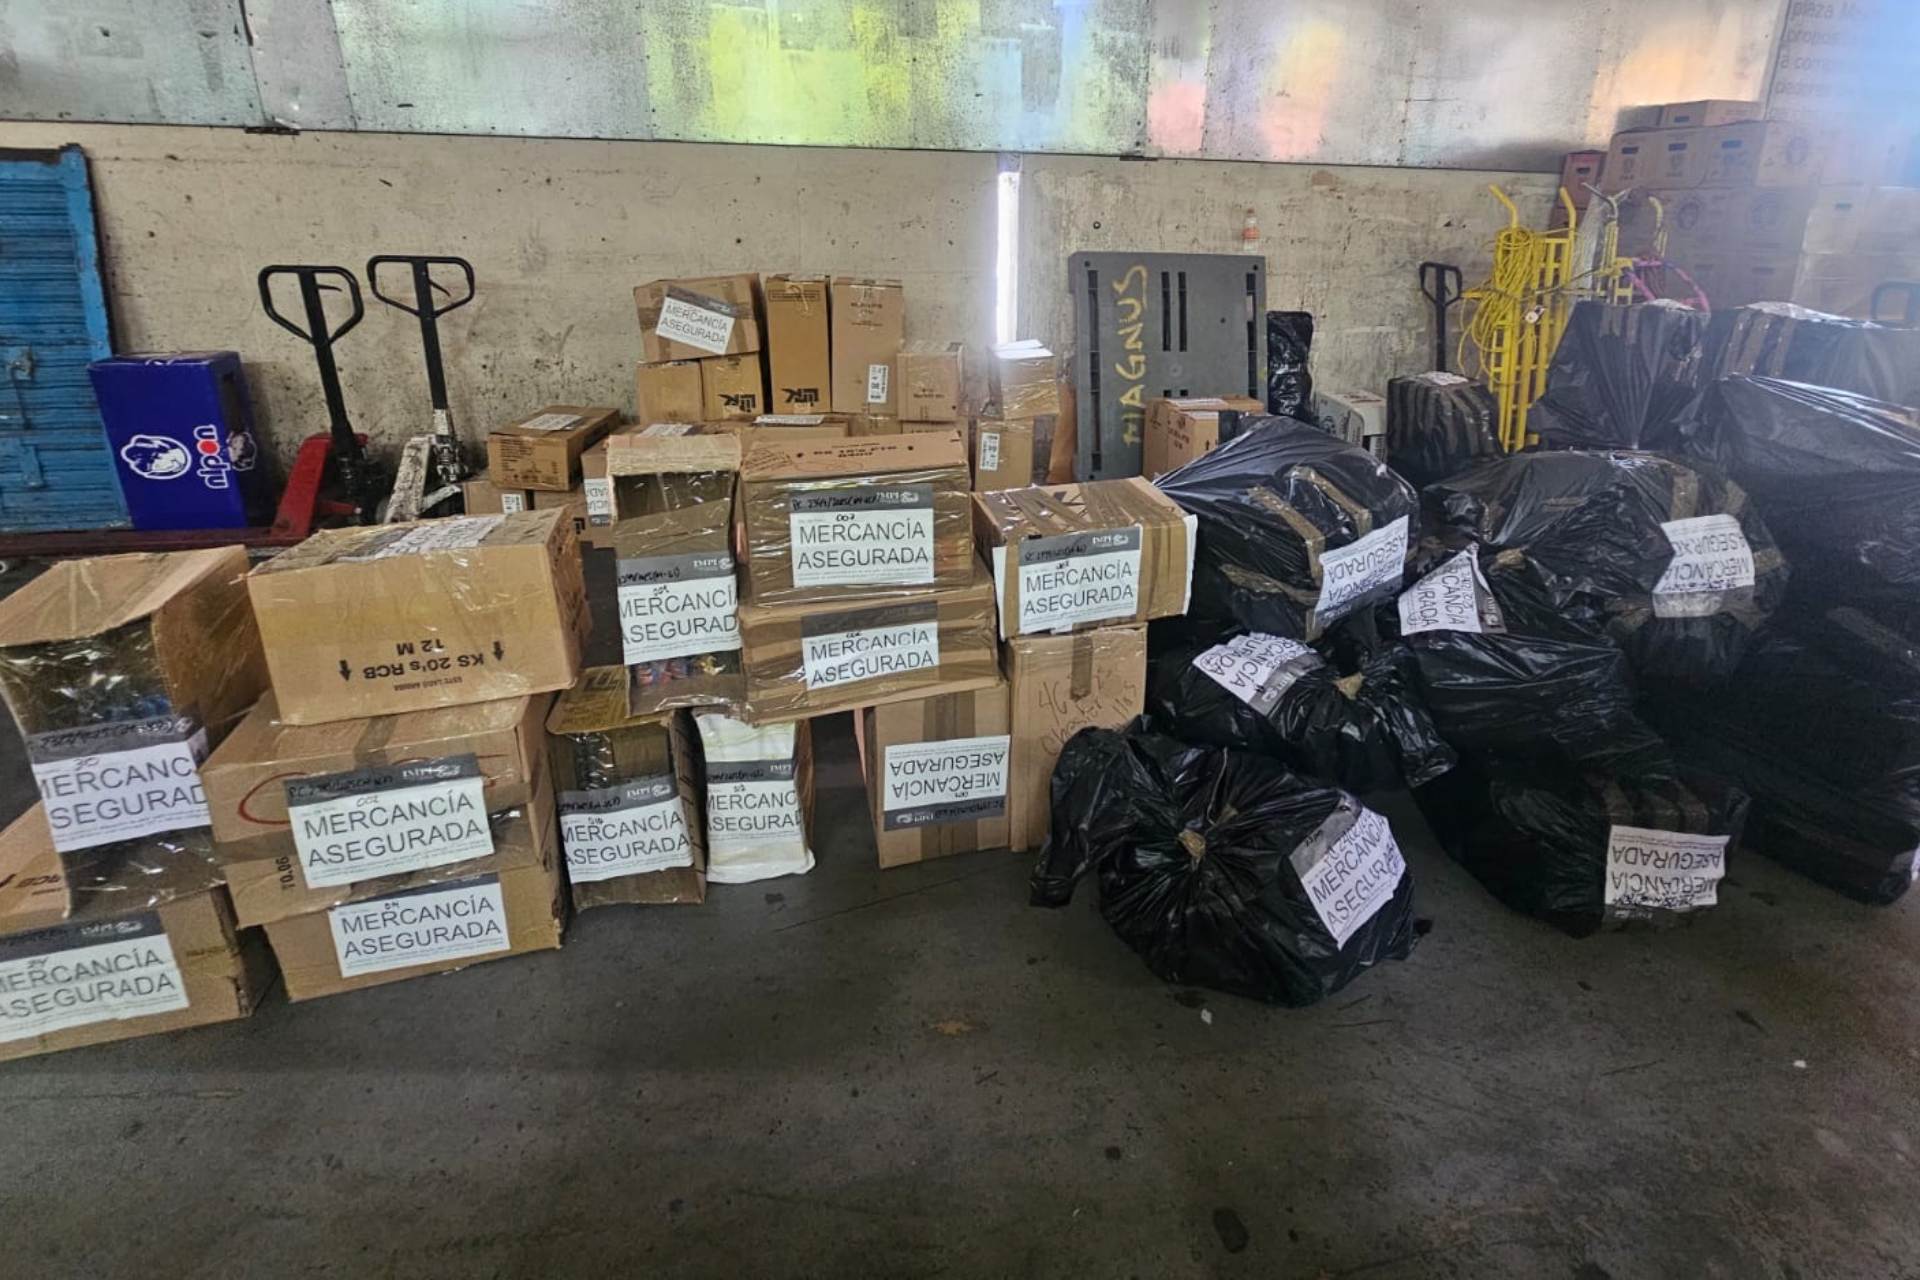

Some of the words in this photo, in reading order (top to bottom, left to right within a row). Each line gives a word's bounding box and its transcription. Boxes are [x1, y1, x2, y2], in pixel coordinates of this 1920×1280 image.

[660, 318, 726, 345] ASEGURADA
[666, 304, 728, 333] MERCANCÍA
[799, 518, 926, 546] MERCANCÍA
[797, 547, 928, 571] ASEGURADA
[1026, 559, 1132, 593] MERCANCÍA
[1024, 583, 1134, 616] ASEGURADA
[396, 642, 415, 656] M
[418, 639, 445, 653] 12
[811, 628, 929, 662] MERCANCÍA
[363, 661, 406, 680] RCB
[409, 655, 451, 671] 20's
[457, 652, 484, 669] KS
[811, 650, 934, 687] ASEGURADA
[890, 751, 1006, 777] ASEGURADA
[892, 770, 1001, 800] MERCANCÍA
[304, 789, 474, 840] MERCANCÍA
[308, 819, 484, 867] ASEGURADA
[1612, 845, 1721, 870] ASEGURADA
[342, 894, 494, 935] MERCANCÍA
[345, 919, 502, 959] ASEGURADA
